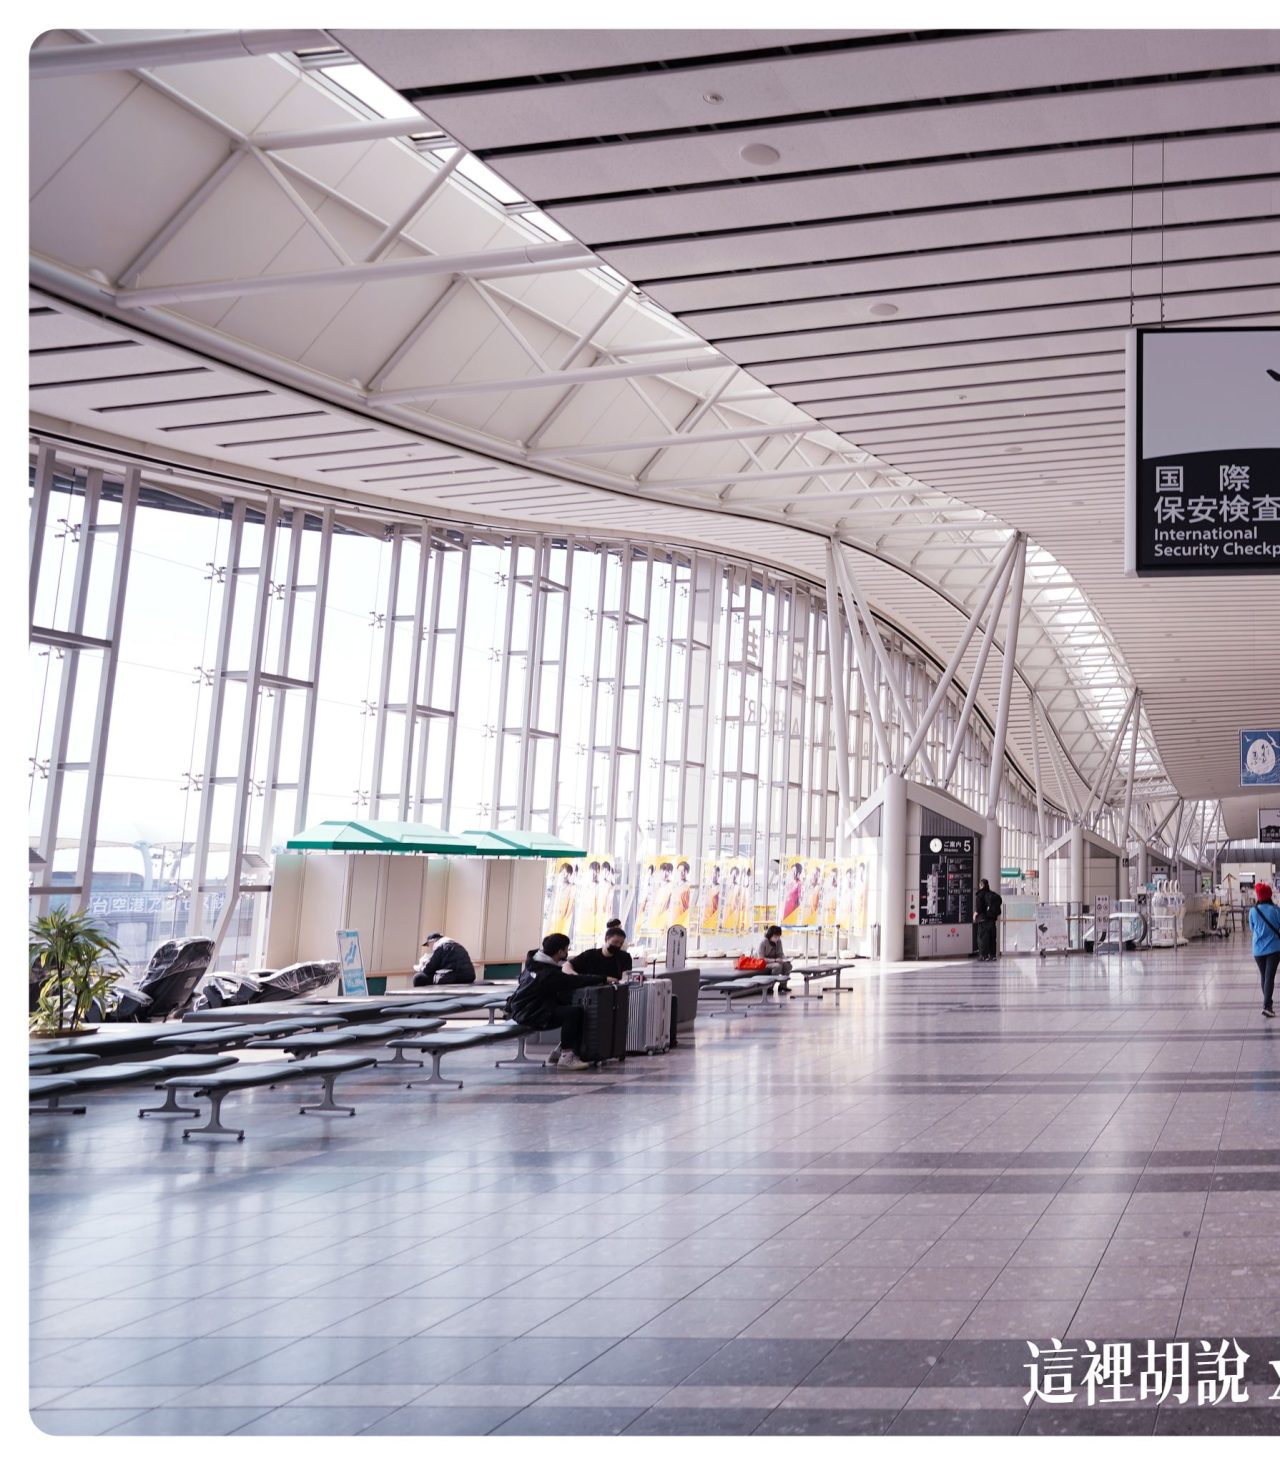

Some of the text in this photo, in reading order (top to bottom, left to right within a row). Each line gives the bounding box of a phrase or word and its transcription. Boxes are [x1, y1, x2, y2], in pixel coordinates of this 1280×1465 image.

[1154, 526, 1258, 541] International
[1154, 542, 1219, 559] Security
[963, 840, 971, 852] 5
